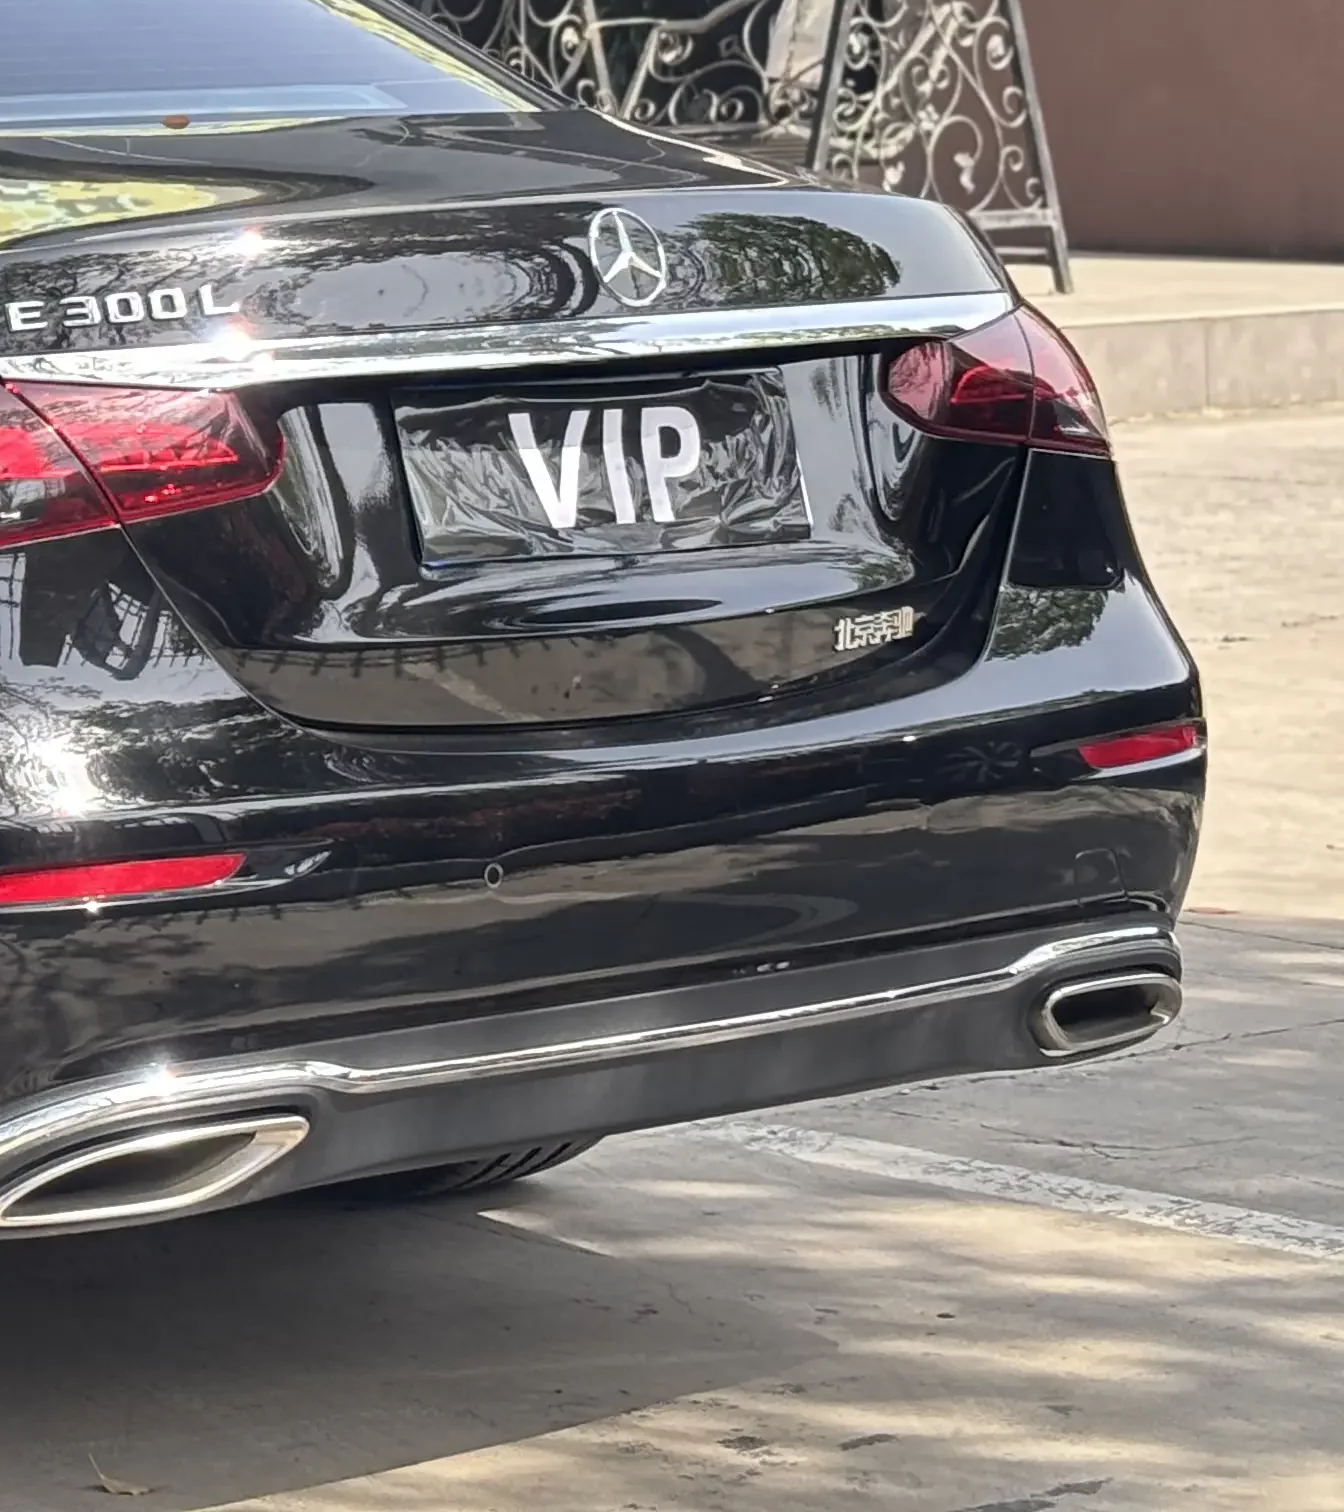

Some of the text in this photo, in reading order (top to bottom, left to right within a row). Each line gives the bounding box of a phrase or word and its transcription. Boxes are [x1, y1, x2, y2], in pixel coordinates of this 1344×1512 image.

[5, 284, 241, 332] E 300 L
[508, 406, 702, 529] VIP
